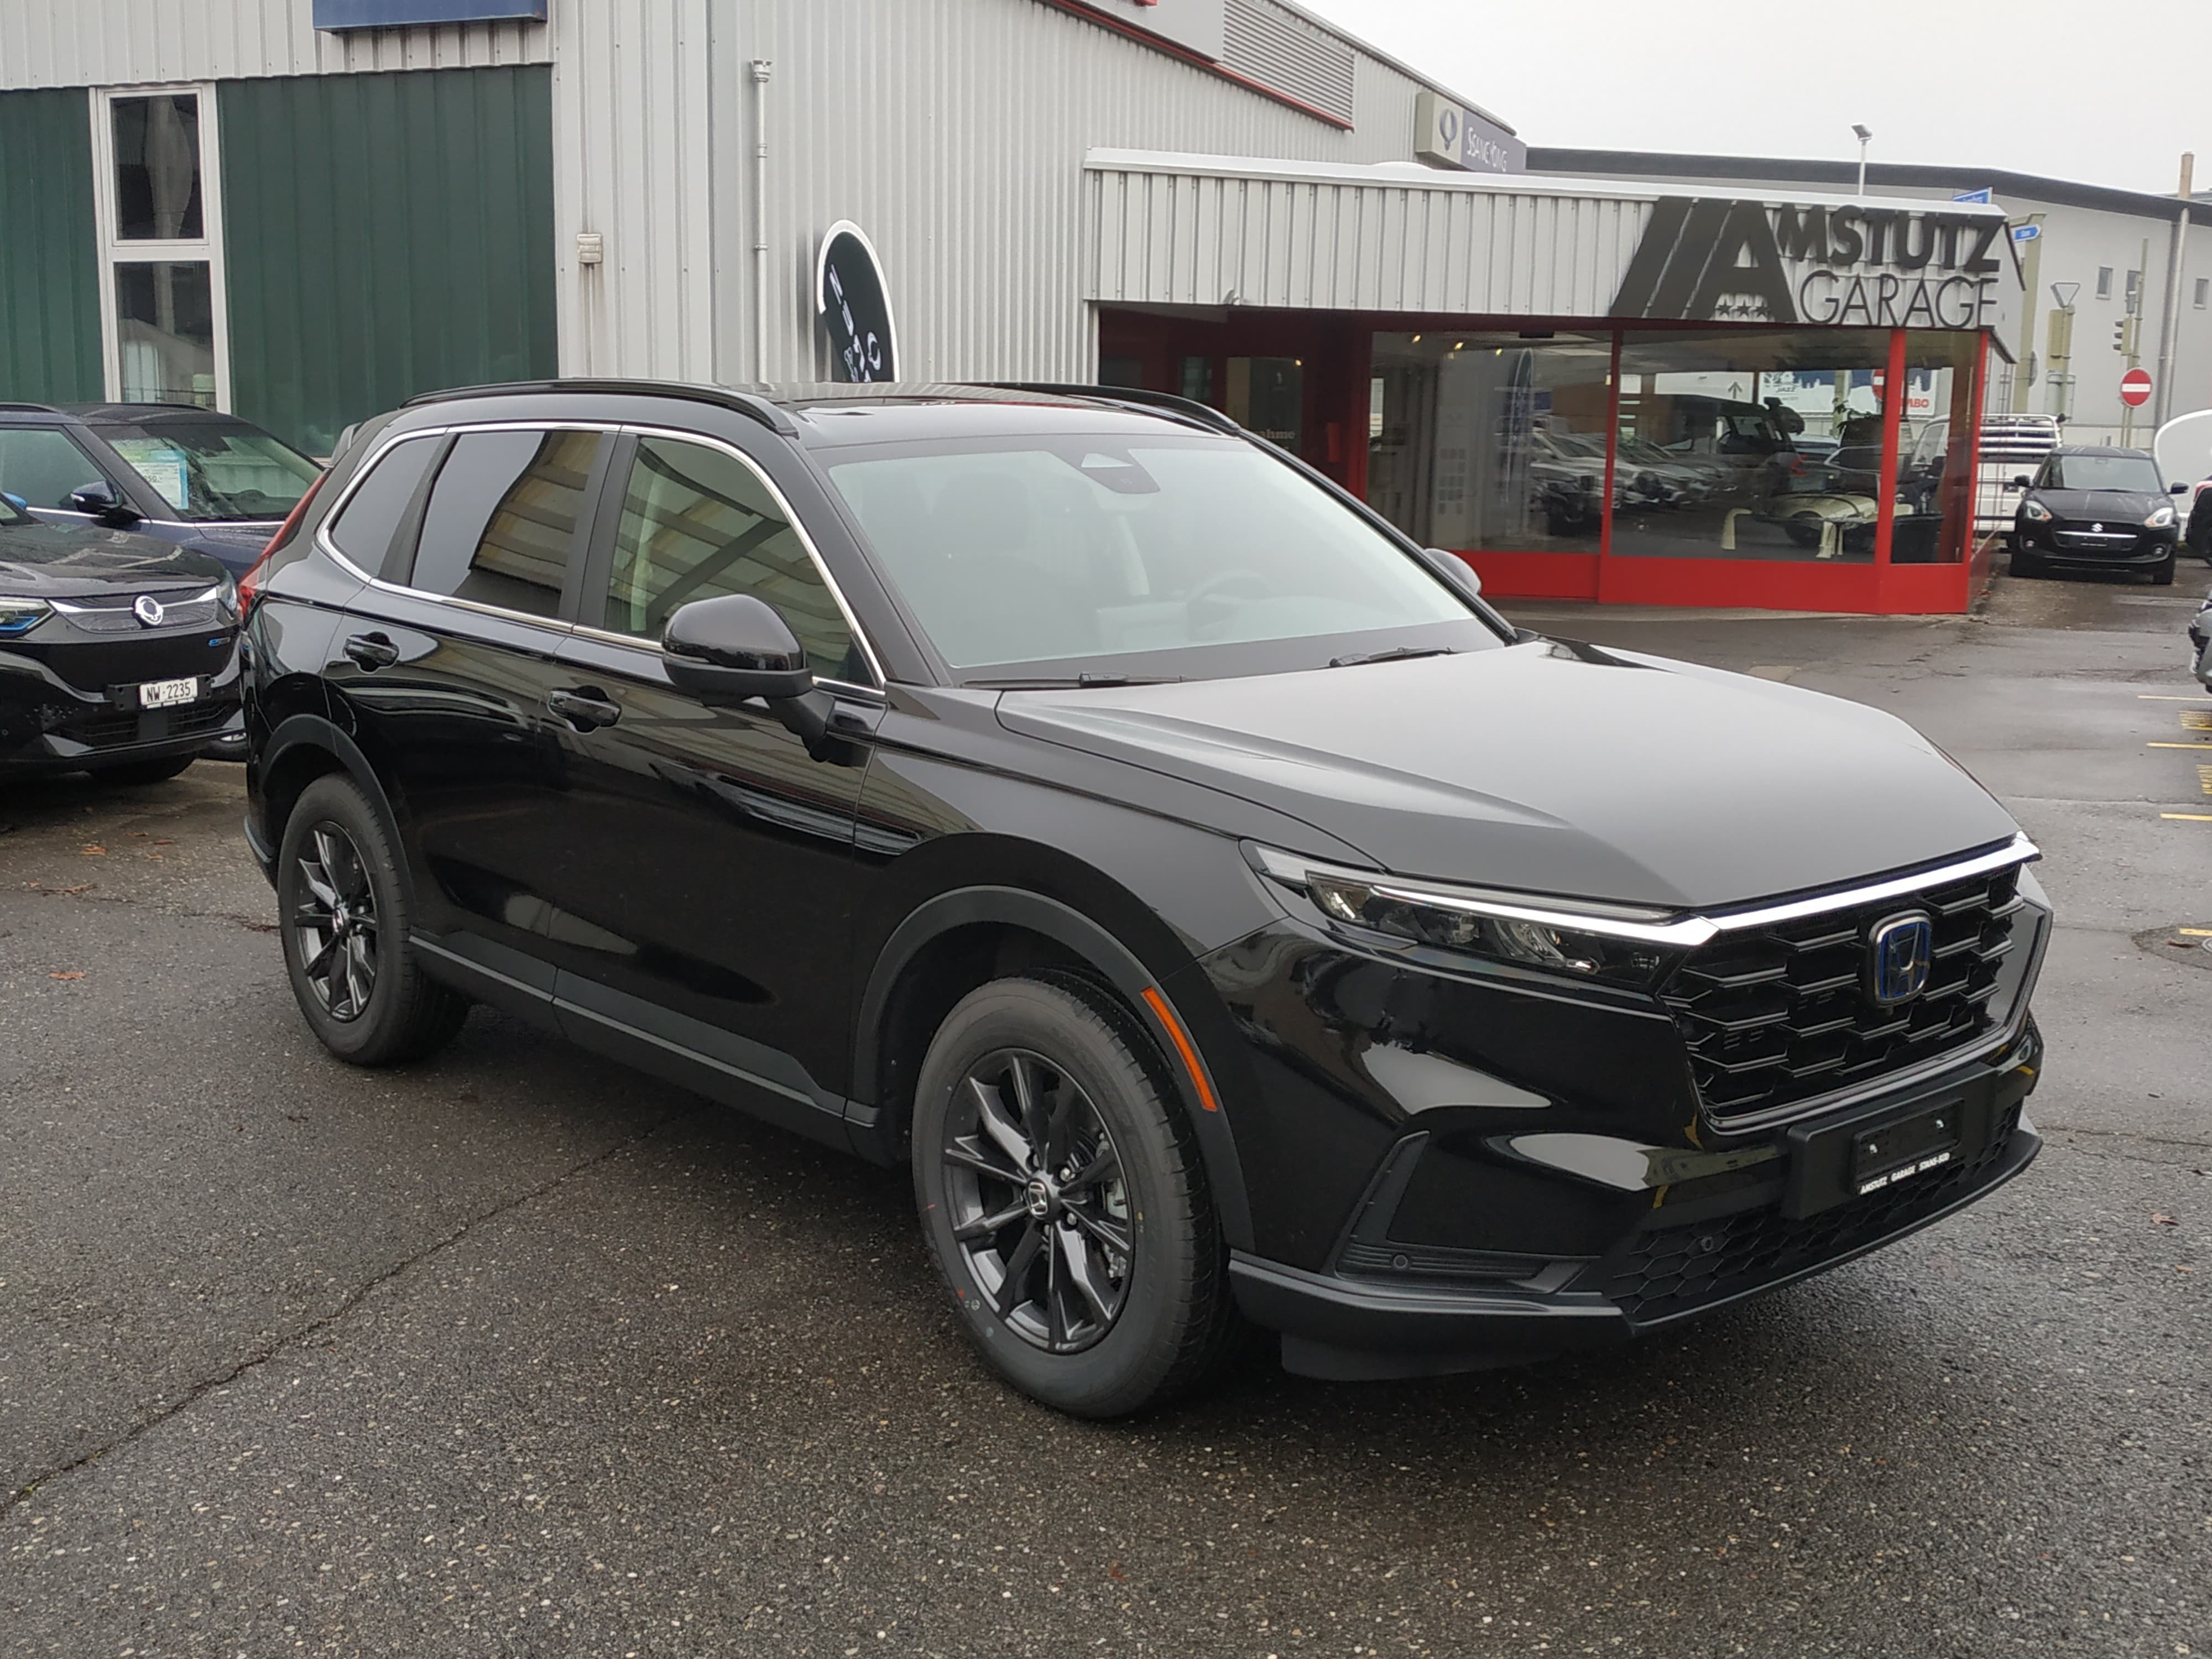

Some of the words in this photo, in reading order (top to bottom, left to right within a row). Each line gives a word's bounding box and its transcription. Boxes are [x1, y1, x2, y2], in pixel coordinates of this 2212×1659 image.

[1681, 199, 2001, 322] AMSTUTZ
[1799, 269, 2000, 329] GARAGE
[166, 681, 191, 699] 2235
